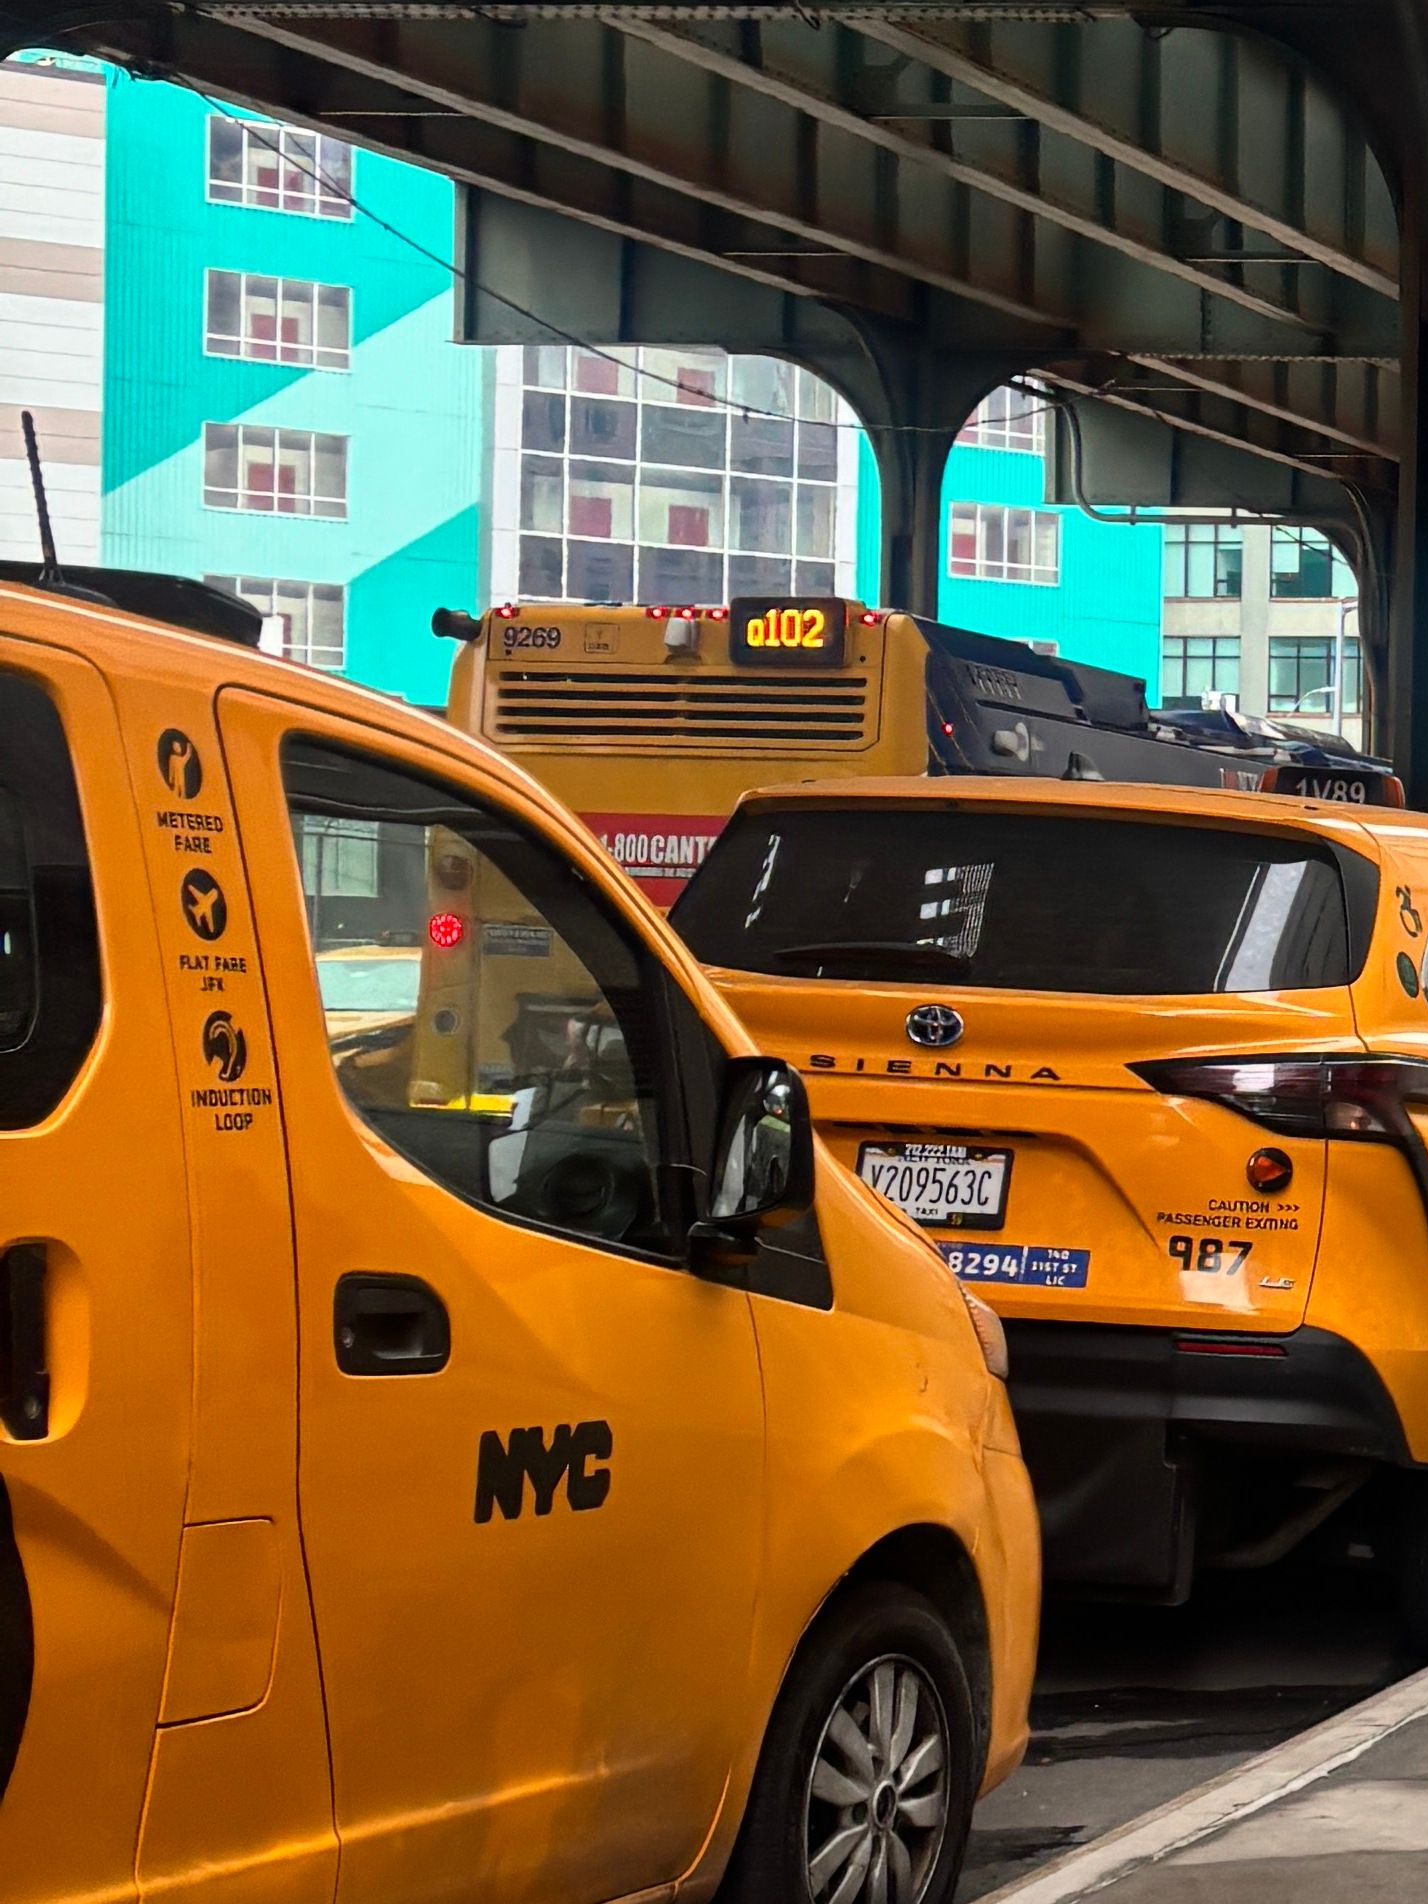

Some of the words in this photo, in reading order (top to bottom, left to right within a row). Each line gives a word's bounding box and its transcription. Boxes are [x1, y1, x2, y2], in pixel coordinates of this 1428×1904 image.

[503, 626, 561, 649] 9269
[1296, 776, 1366, 804] 1V89
[157, 810, 225, 832] METERED
[174, 834, 213, 854] FARE
[599, 832, 719, 865] 1-800CANT
[179, 955, 209, 972] FLAT
[214, 957, 247, 974] FARE
[200, 976, 224, 992] JFK
[810, 1054, 1060, 1080] SIENNA
[191, 1088, 272, 1107] INDUCTION
[214, 1112, 253, 1132] LOOP
[871, 1163, 992, 1207] Y209563C
[1208, 1199, 1270, 1213] CAUTION
[1157, 1211, 1241, 1228] PASSENGER
[1245, 1216, 1298, 1230] EXITING
[1168, 1234, 1254, 1275] 987
[473, 1419, 613, 1524] NYC
